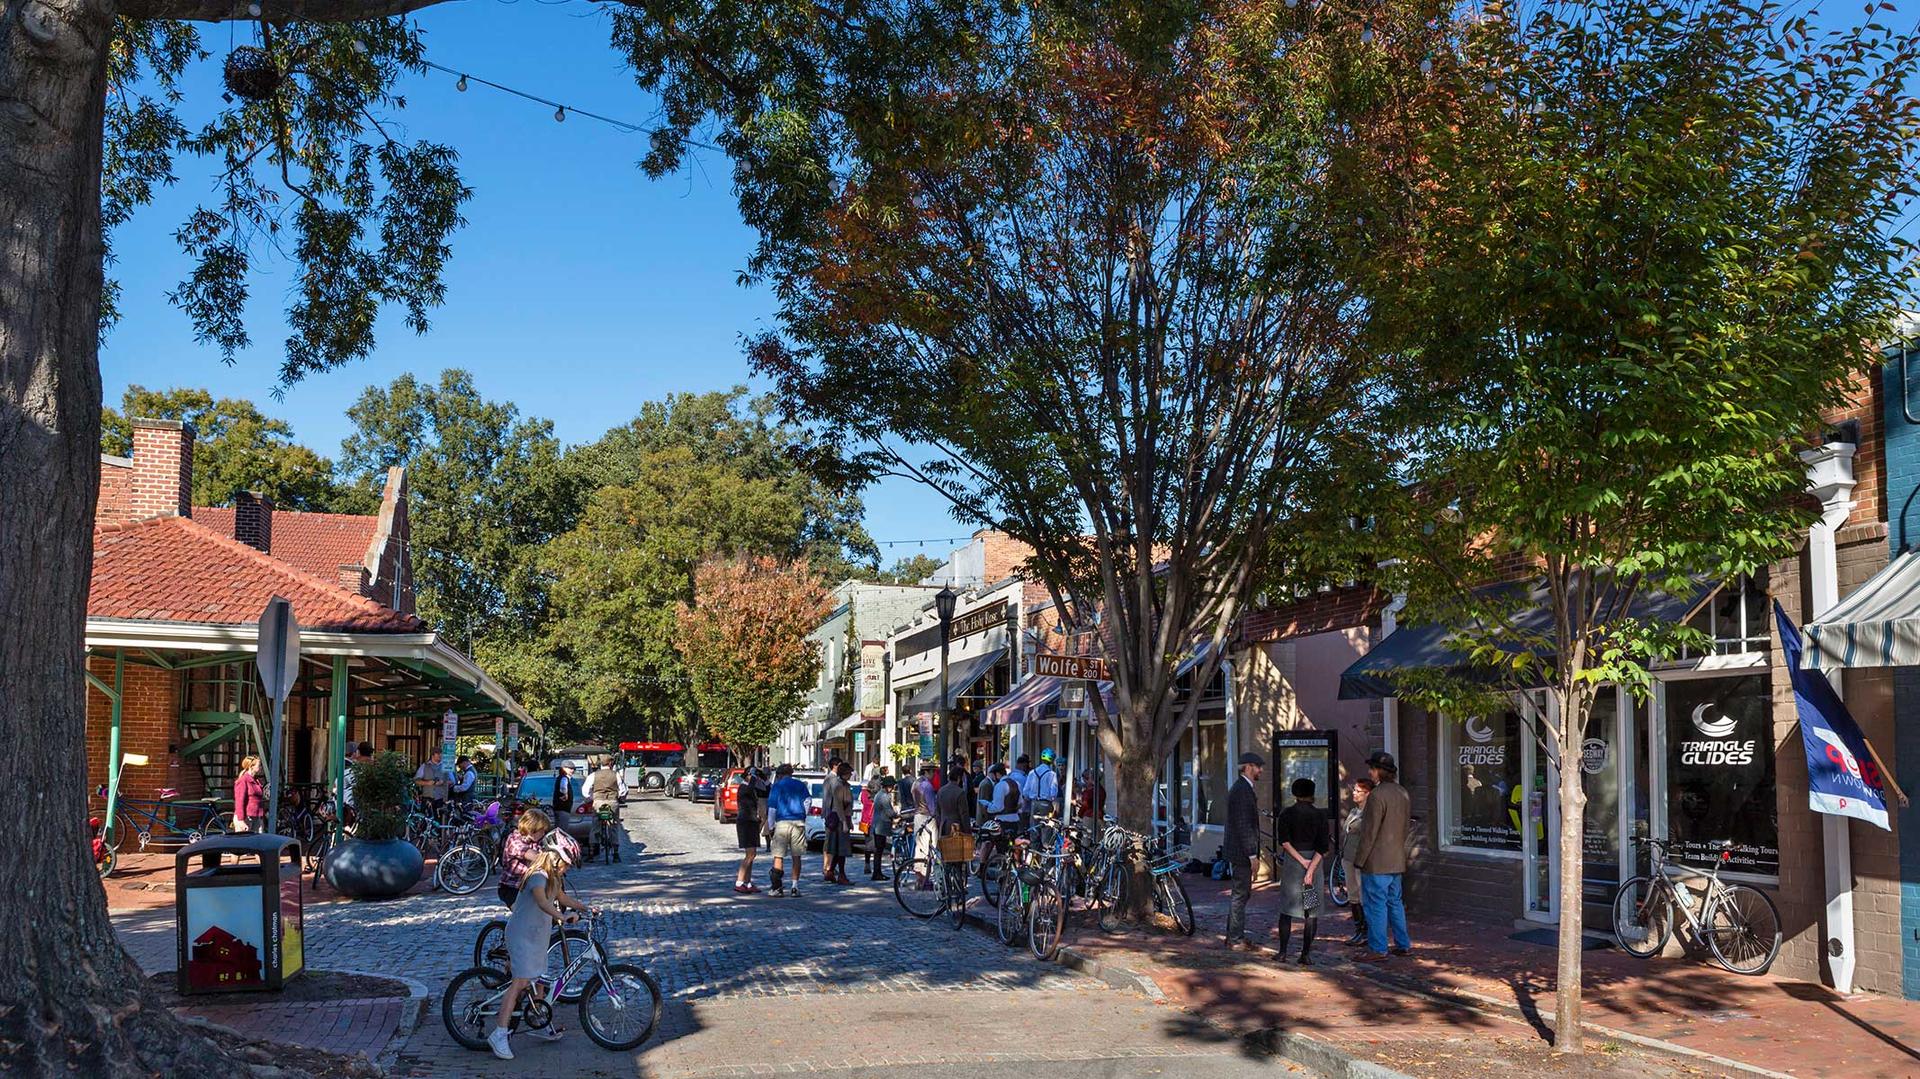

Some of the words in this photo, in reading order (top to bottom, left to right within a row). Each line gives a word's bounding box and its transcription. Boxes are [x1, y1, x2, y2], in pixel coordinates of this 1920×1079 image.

[960, 618, 970, 633] The
[1040, 656, 1078, 676] Wolfe
[1089, 660, 1099, 669] ST
[1083, 669, 1098, 679] 200
[1459, 745, 1506, 754] TRIANGLE
[1681, 740, 1755, 752] TRIANGLE
[1459, 754, 1504, 765] GLIDES
[1681, 752, 1753, 765] GLIDES
[1685, 841, 1701, 849] Tours
[1734, 844, 1759, 855] alking
[1760, 845, 1778, 854] Tours
[1684, 852, 1700, 860] Team
[1701, 853, 1727, 864] Buildig
